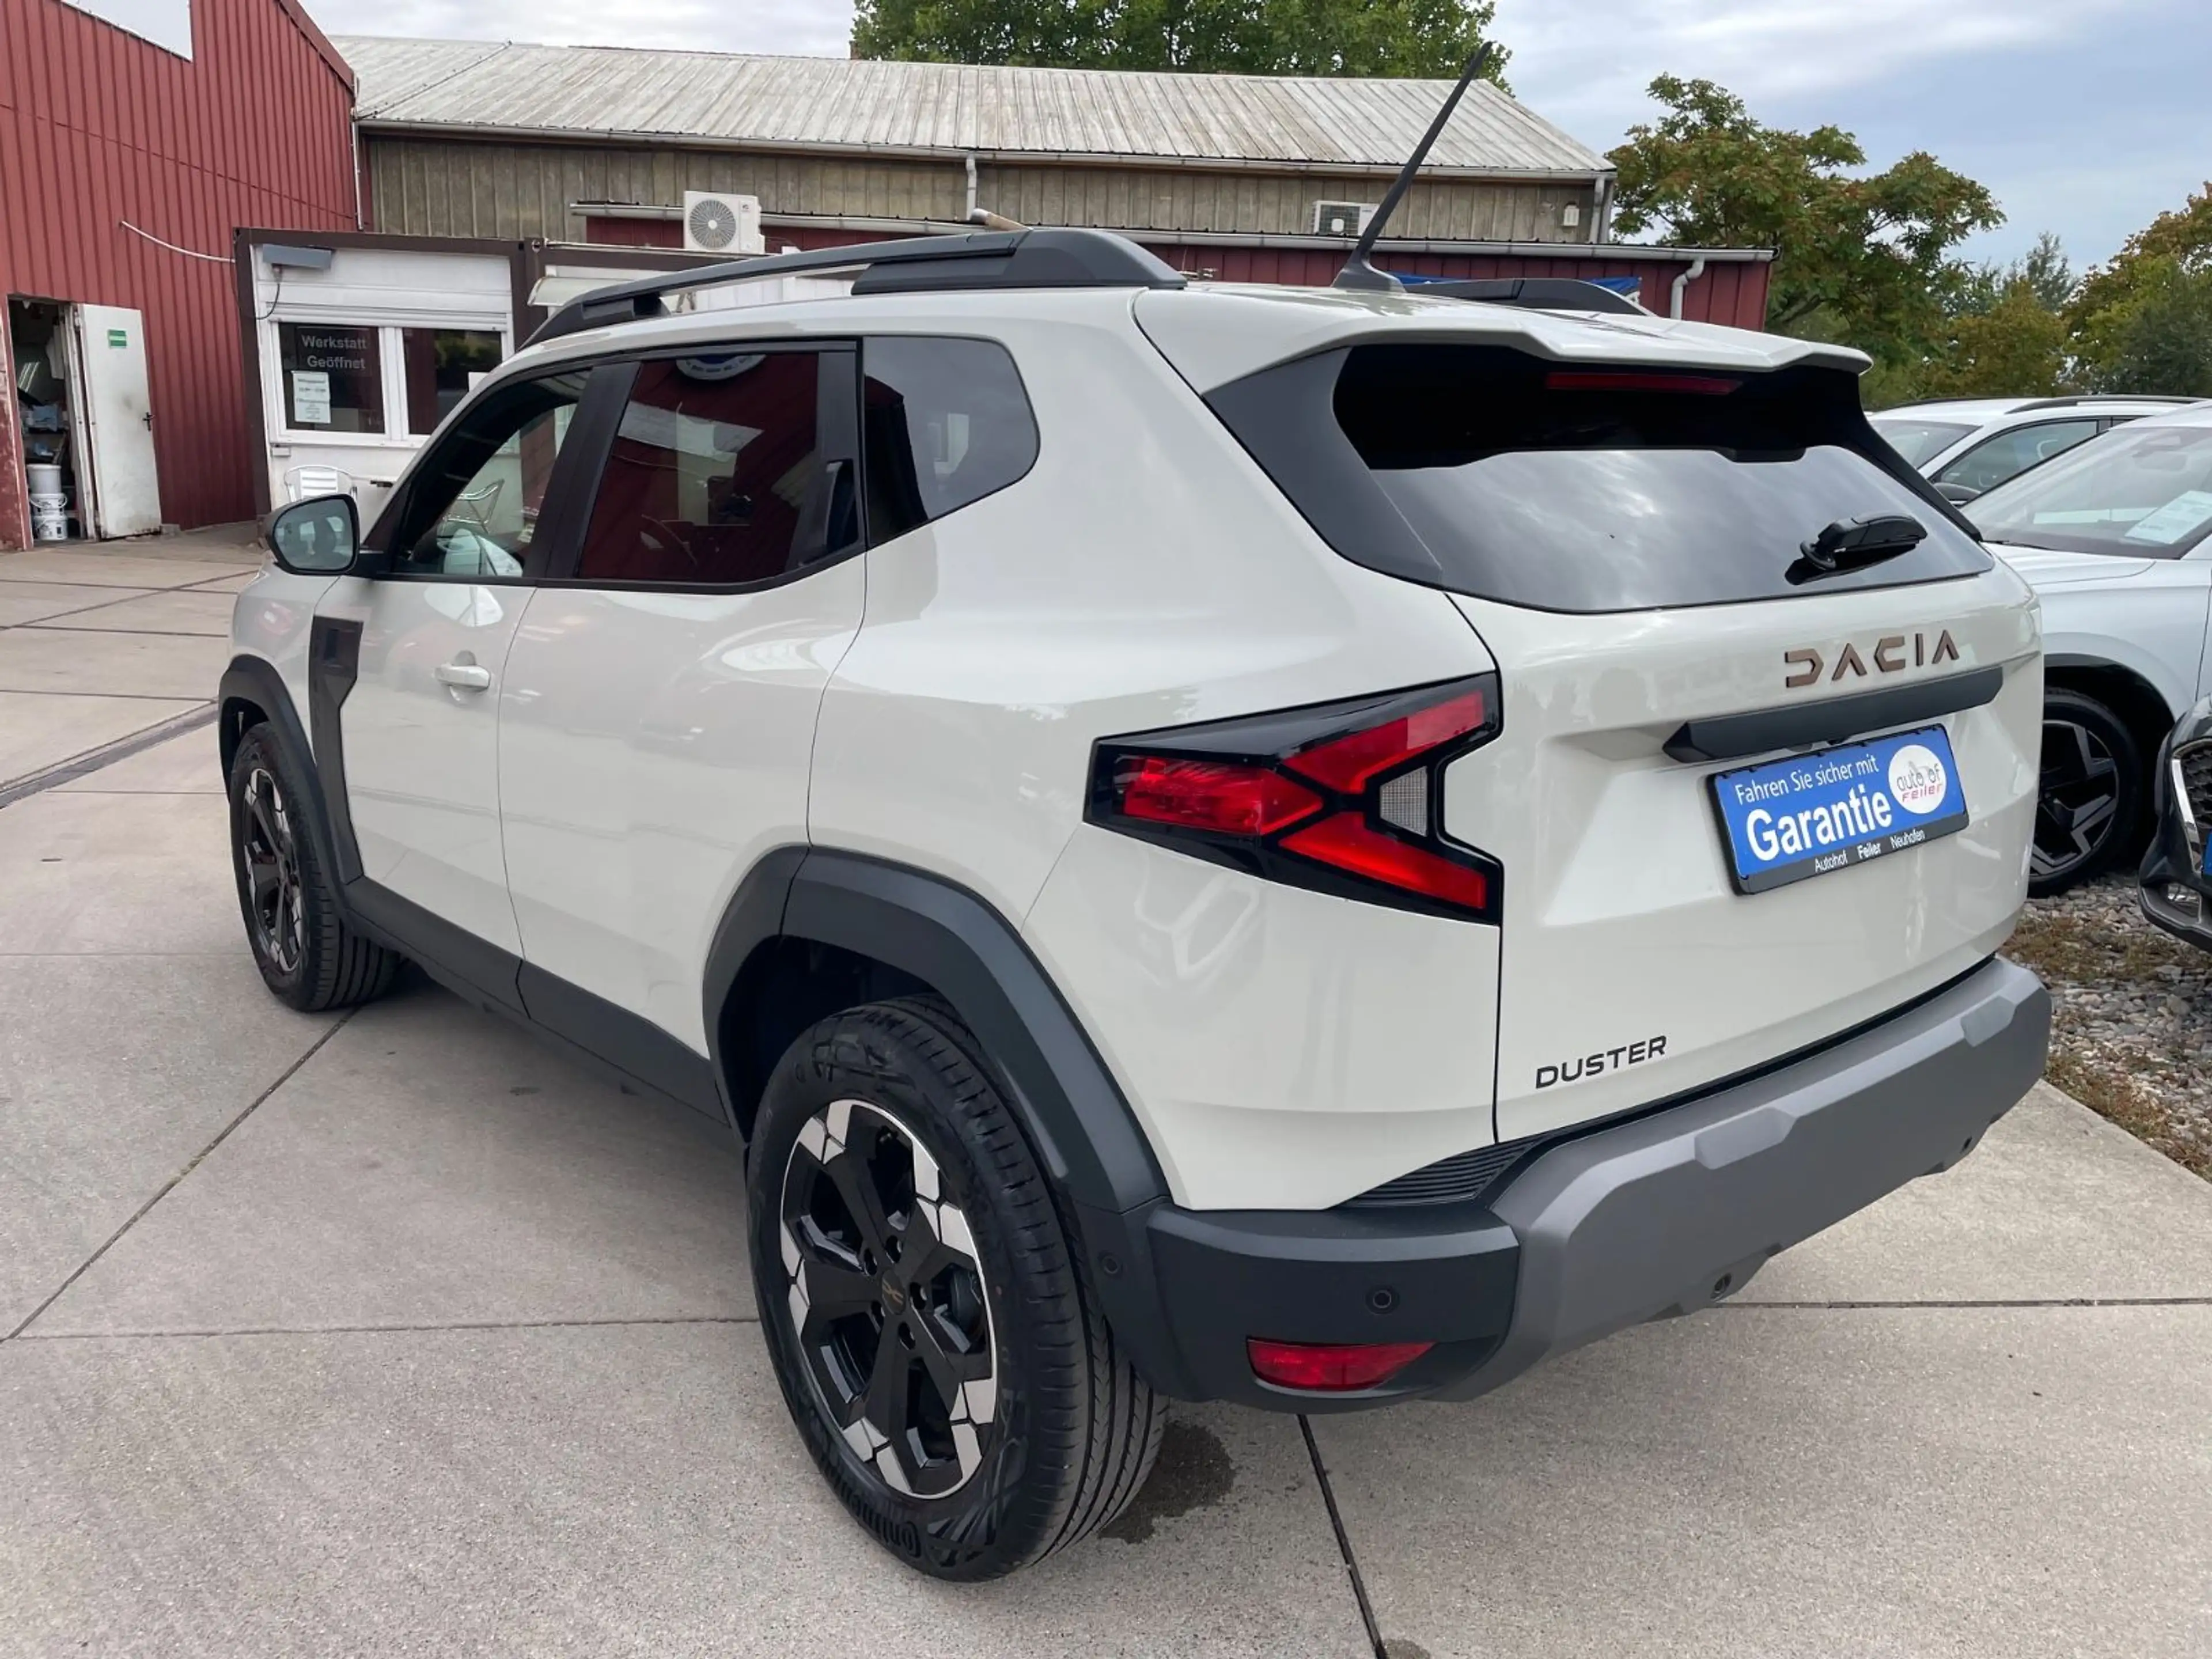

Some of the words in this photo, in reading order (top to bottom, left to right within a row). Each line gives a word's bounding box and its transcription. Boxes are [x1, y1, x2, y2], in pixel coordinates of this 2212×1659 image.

[301, 334, 367, 349] Werkstatt
[307, 355, 365, 369] Geöffnet
[1785, 629, 1960, 688] DACIA
[1735, 779, 1789, 805] Fahren
[1790, 770, 1813, 791] Sie
[1815, 762, 1853, 786] sicher
[1856, 753, 1879, 776] mit
[1746, 783, 1892, 862] Garantie
[1815, 850, 1848, 873] Autohof
[1857, 842, 1881, 859] Feiler
[1890, 828, 1925, 849] Neuhofen
[1535, 1035, 1666, 1089] DUSTER
